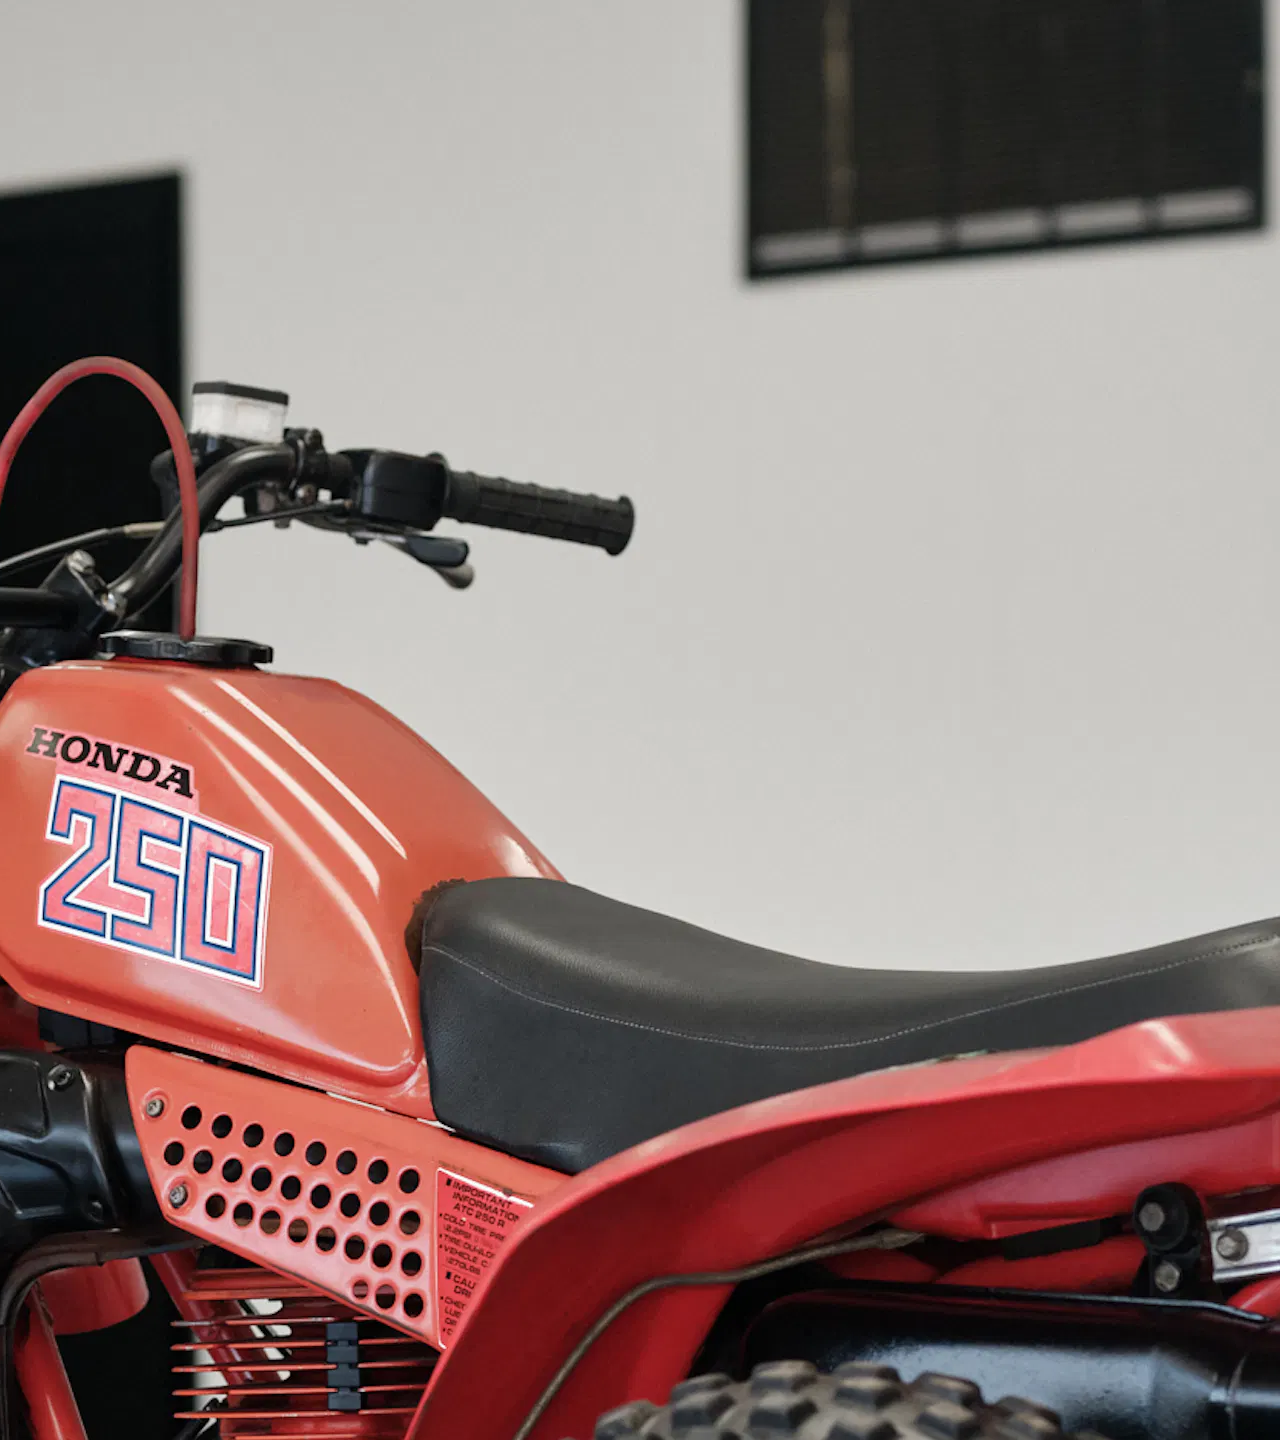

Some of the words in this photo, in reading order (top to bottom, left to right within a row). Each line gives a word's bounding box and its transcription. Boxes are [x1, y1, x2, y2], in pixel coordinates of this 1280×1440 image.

[26, 727, 195, 798] HONDA
[38, 774, 272, 991] 250
[452, 1180, 512, 1209] IMPORTANT
[443, 1212, 466, 1227] COLD
[468, 1222, 487, 1236] TIRE
[453, 1202, 474, 1217] ATC
[475, 1210, 496, 1225] 250
[497, 1219, 506, 1229] R
[444, 1233, 462, 1247] TIRE
